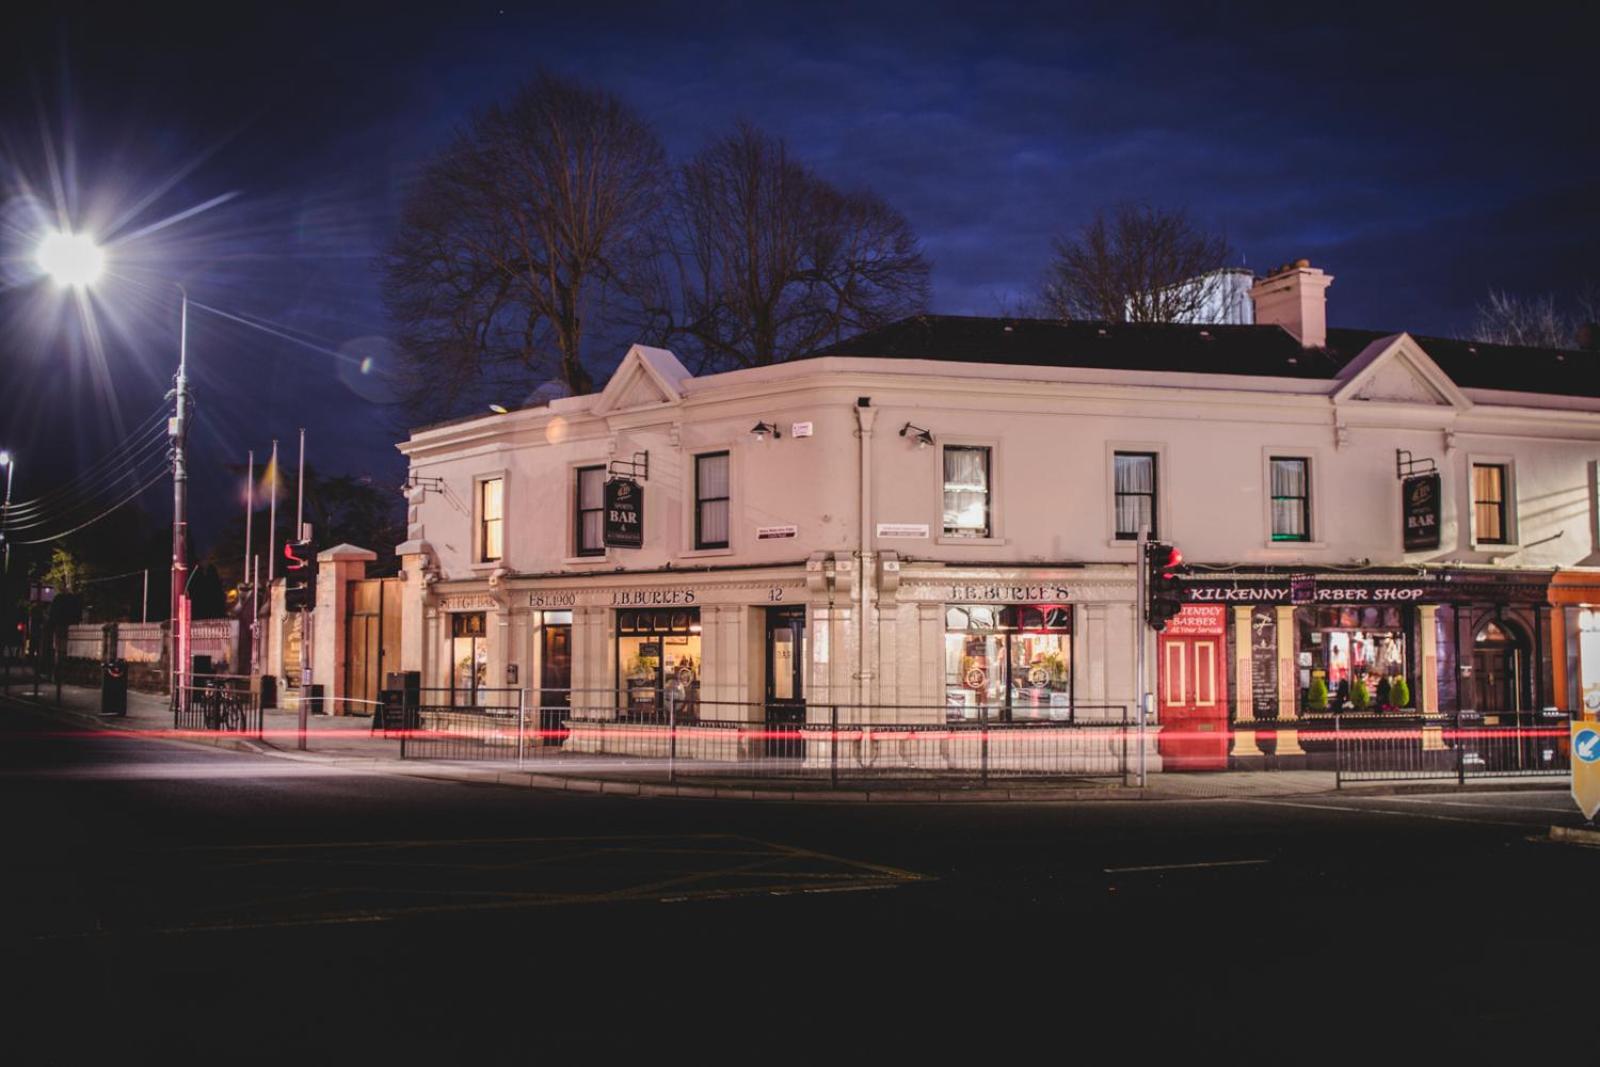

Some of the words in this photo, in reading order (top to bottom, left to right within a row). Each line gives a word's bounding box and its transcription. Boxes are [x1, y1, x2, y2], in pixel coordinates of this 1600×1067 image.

[610, 510, 638, 524] BAR
[1408, 514, 1435, 528] BAR
[612, 590, 695, 605] J.B.BURKE'S
[953, 586, 1069, 600] J.B.BURKE'S
[1191, 588, 1289, 600] KILKENNY
[1312, 588, 1368, 600] RBER
[1373, 588, 1423, 600] SHOP
[1173, 617, 1217, 626] BARBER
